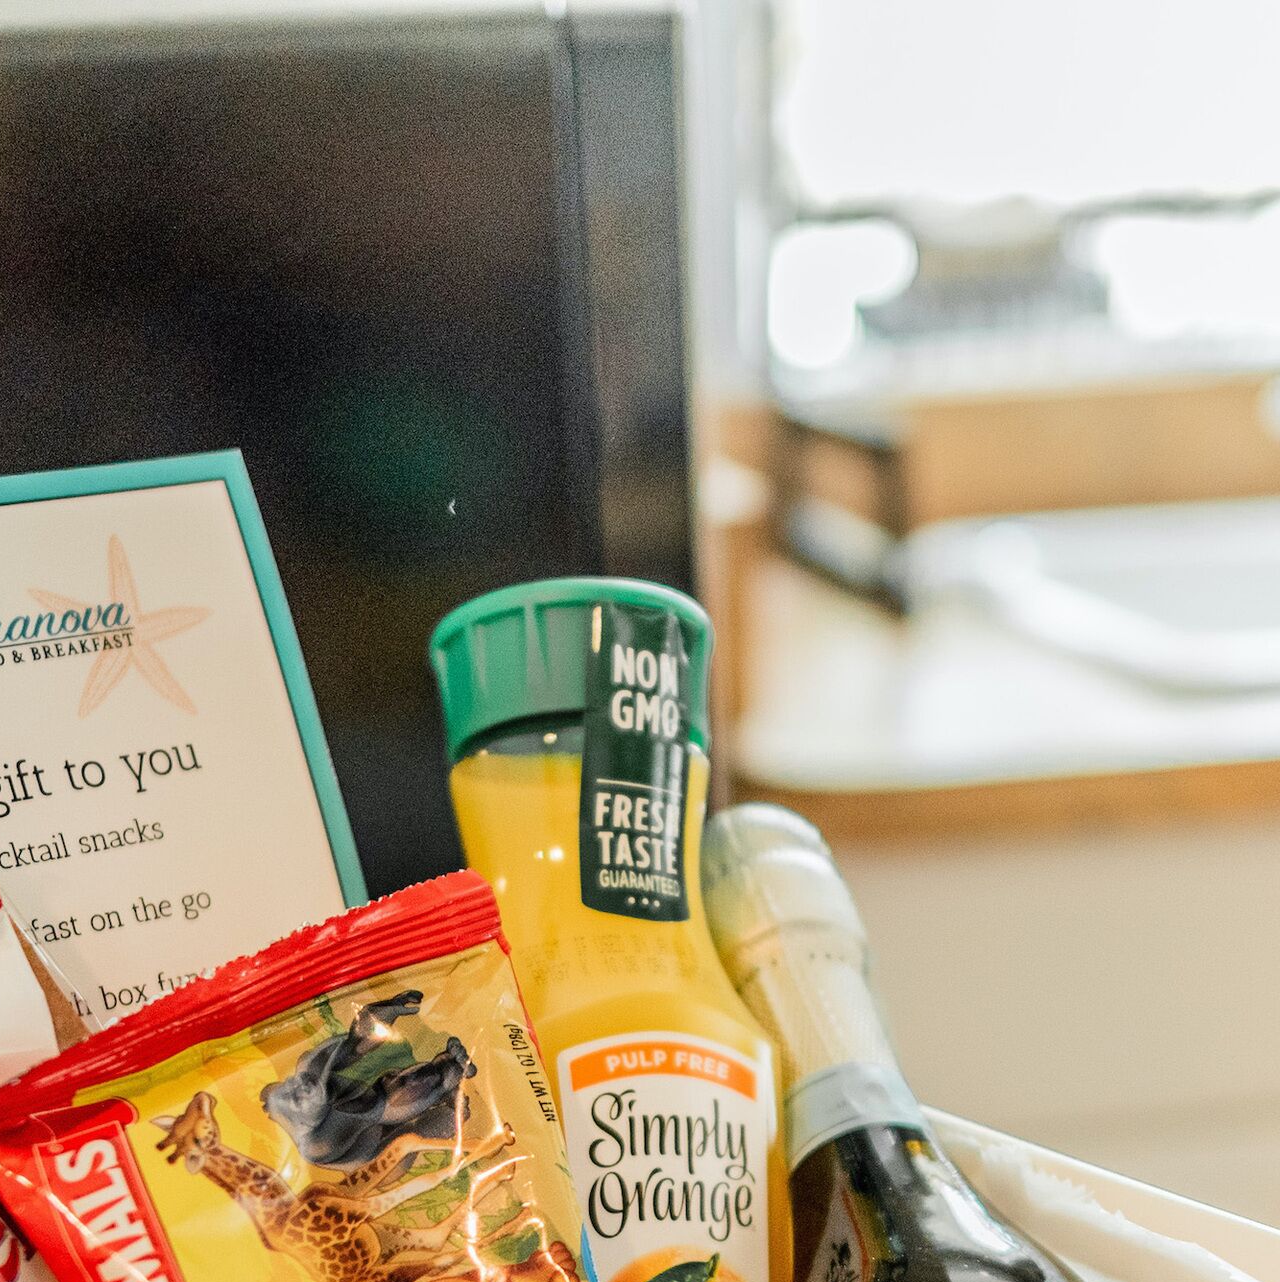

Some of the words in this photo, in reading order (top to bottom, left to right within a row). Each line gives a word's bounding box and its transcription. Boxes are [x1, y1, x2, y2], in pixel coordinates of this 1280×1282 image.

[12, 650, 25, 664] &
[31, 632, 135, 662] BREAKFAST
[612, 643, 679, 698] NON
[611, 689, 681, 739] GMO
[63, 759, 106, 791] to
[119, 743, 203, 793] you
[595, 792, 681, 840] FRESH
[79, 818, 165, 855] snacks
[597, 831, 679, 876] TASTE
[599, 869, 681, 898] GUARANTEED
[89, 911, 124, 932] on
[132, 897, 173, 923] the
[181, 892, 212, 920] go
[98, 983, 148, 1011] box
[503, 1023, 530, 1050] (28g)
[517, 1052, 536, 1067] OZ
[605, 1048, 668, 1073] PULP
[675, 1050, 731, 1080] FREE
[529, 1080, 548, 1098] WT
[539, 1100, 557, 1122] NET
[588, 1088, 756, 1184] Simply
[588, 1167, 753, 1242] Orange
